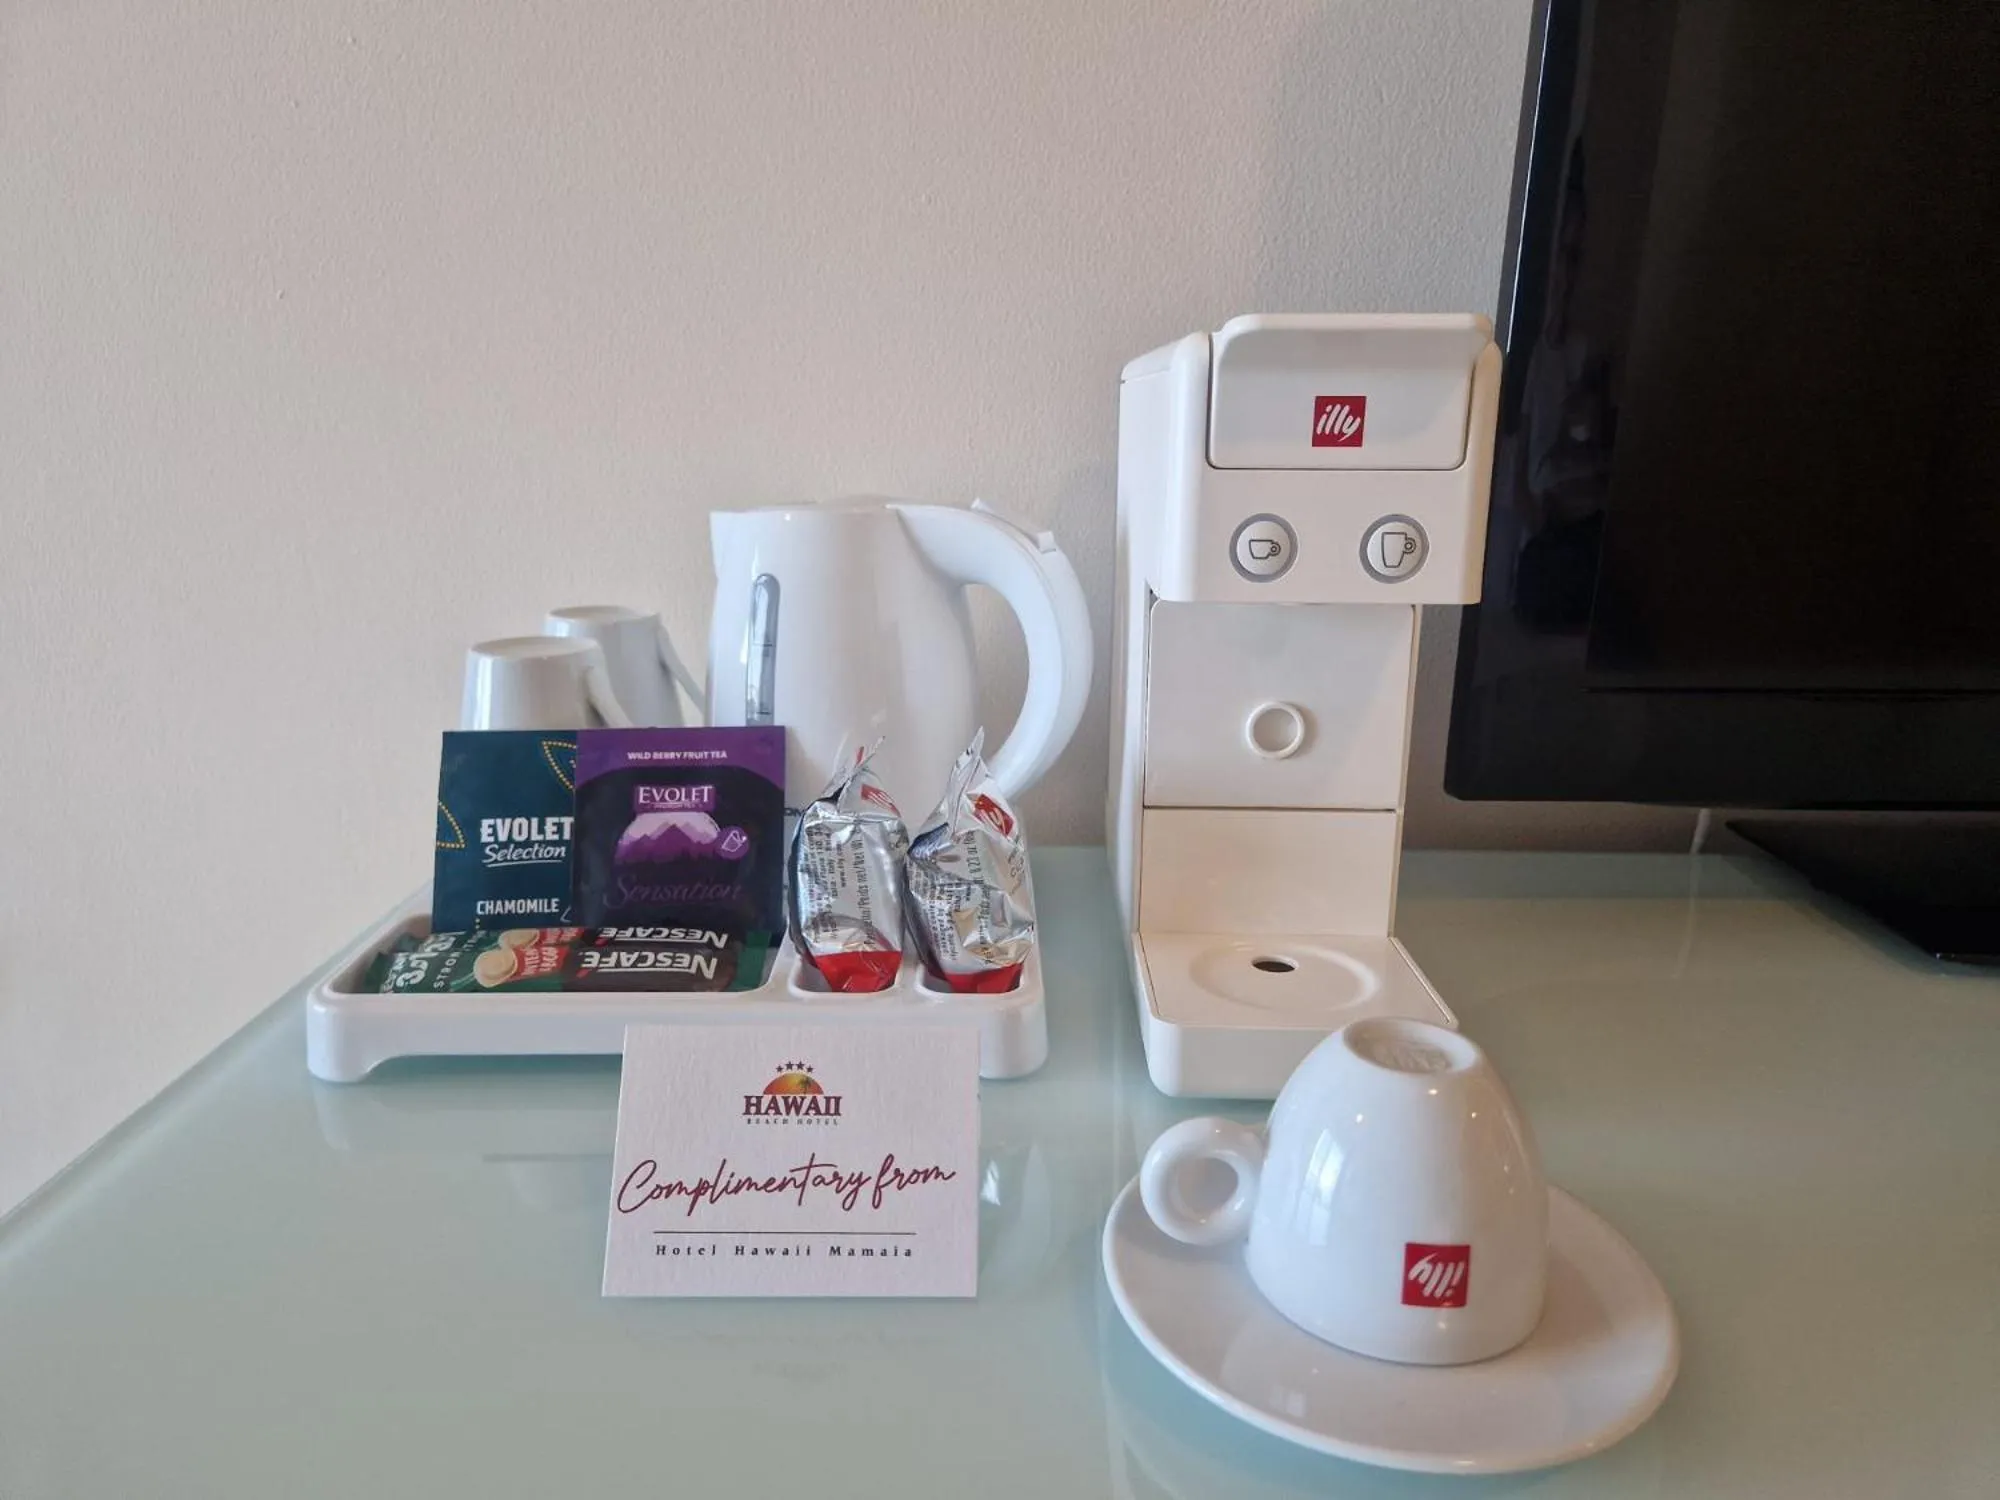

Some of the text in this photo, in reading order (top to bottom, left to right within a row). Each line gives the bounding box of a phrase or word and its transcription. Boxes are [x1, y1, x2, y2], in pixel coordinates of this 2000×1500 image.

[1315, 404, 1362, 441] illy
[627, 750, 728, 760] WILD BERRY FRUIT TEA
[638, 785, 715, 804] EVOLET
[480, 816, 575, 843] EVOLET
[482, 844, 566, 863] Selection
[604, 876, 743, 906] Sensation
[476, 898, 560, 915] CHAMOMILE
[742, 1095, 843, 1117] HAWAII
[617, 1153, 956, 1217] Complimentary from
[655, 1244, 913, 1258] Hotel Hawaii Mamaia
[1408, 1253, 1465, 1299] illy
